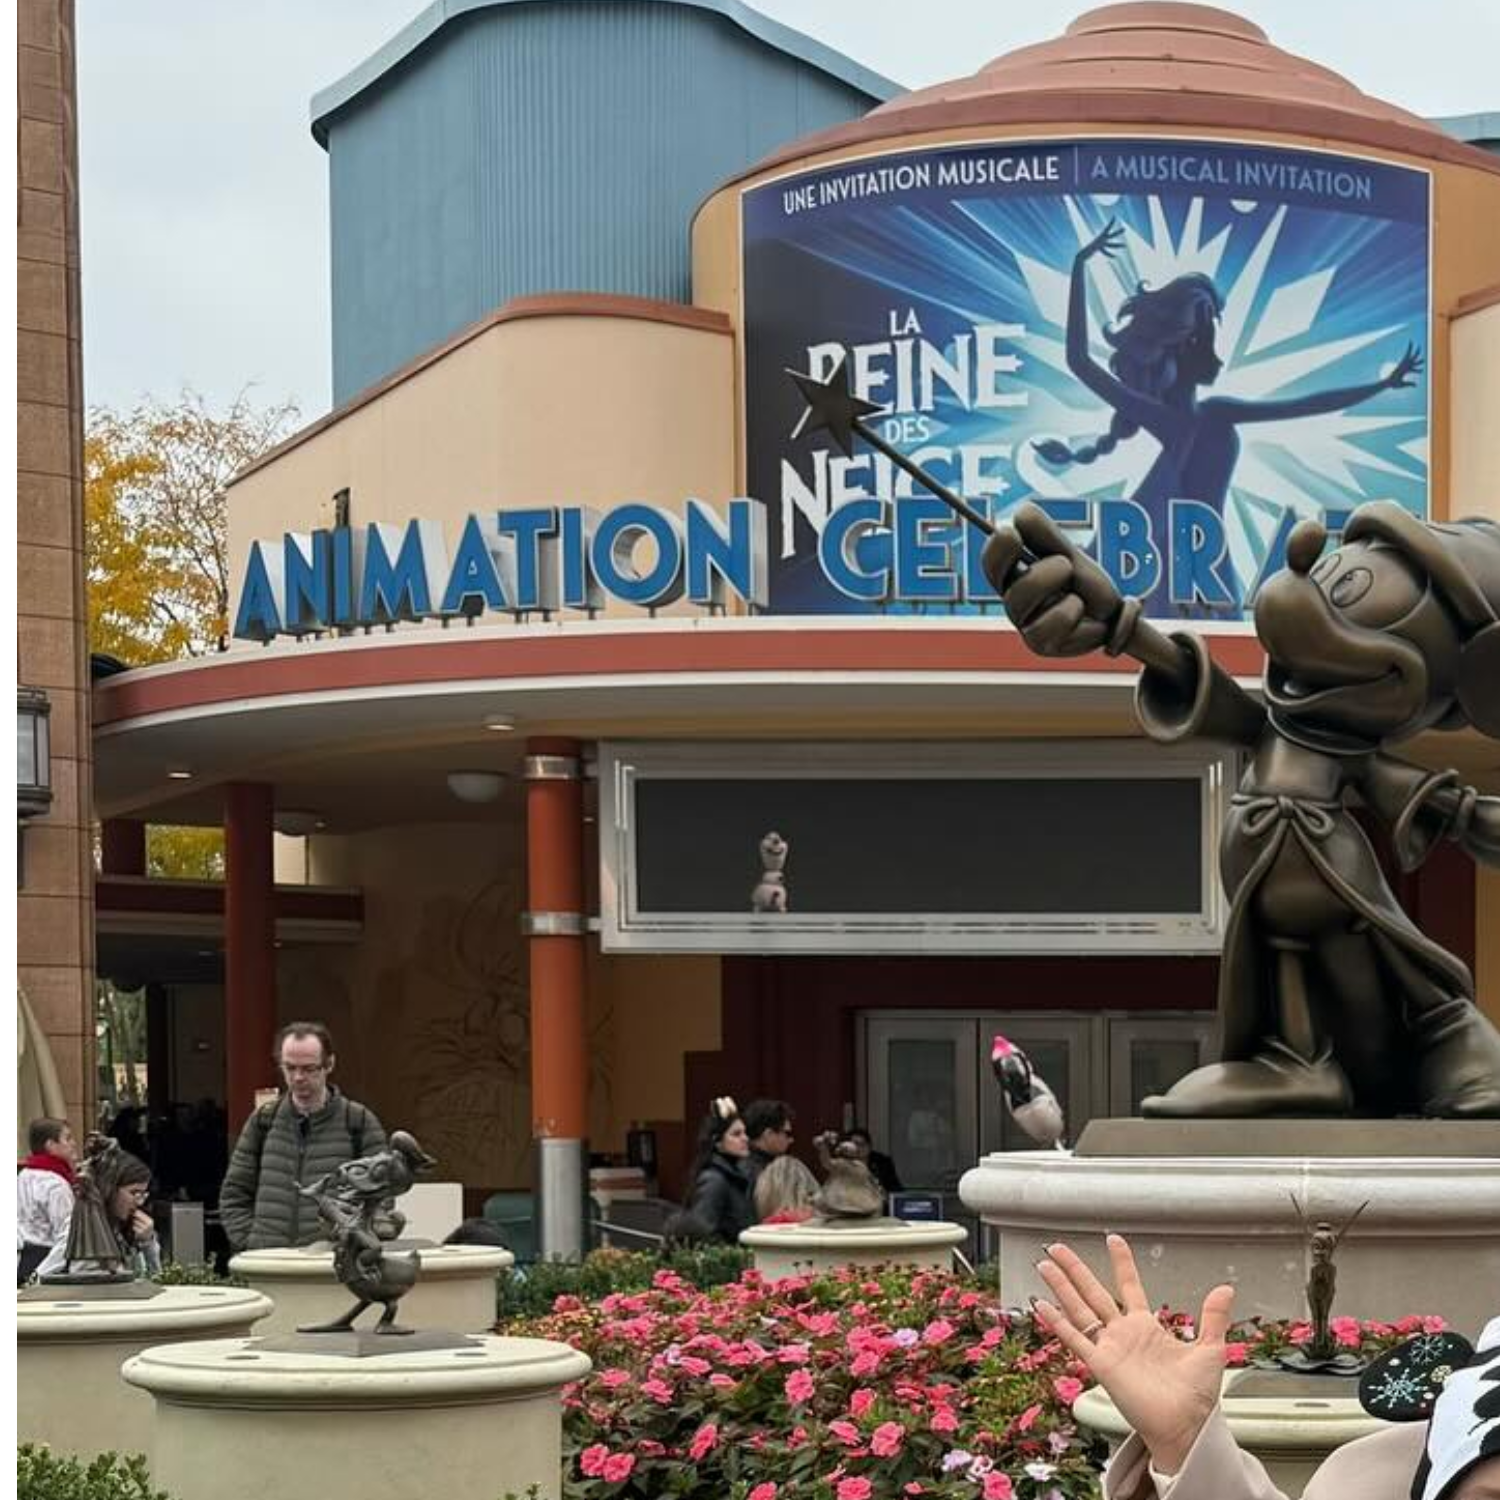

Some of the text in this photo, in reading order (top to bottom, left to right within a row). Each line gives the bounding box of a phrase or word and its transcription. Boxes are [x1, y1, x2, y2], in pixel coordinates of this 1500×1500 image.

[783, 156, 1060, 215] UNE INVITATION MUSICALE
[1091, 156, 1373, 201] A MUSICAL INVITATION
[889, 307, 921, 336] LA
[884, 416, 930, 444] DES
[232, 497, 767, 641] ANIMATION
